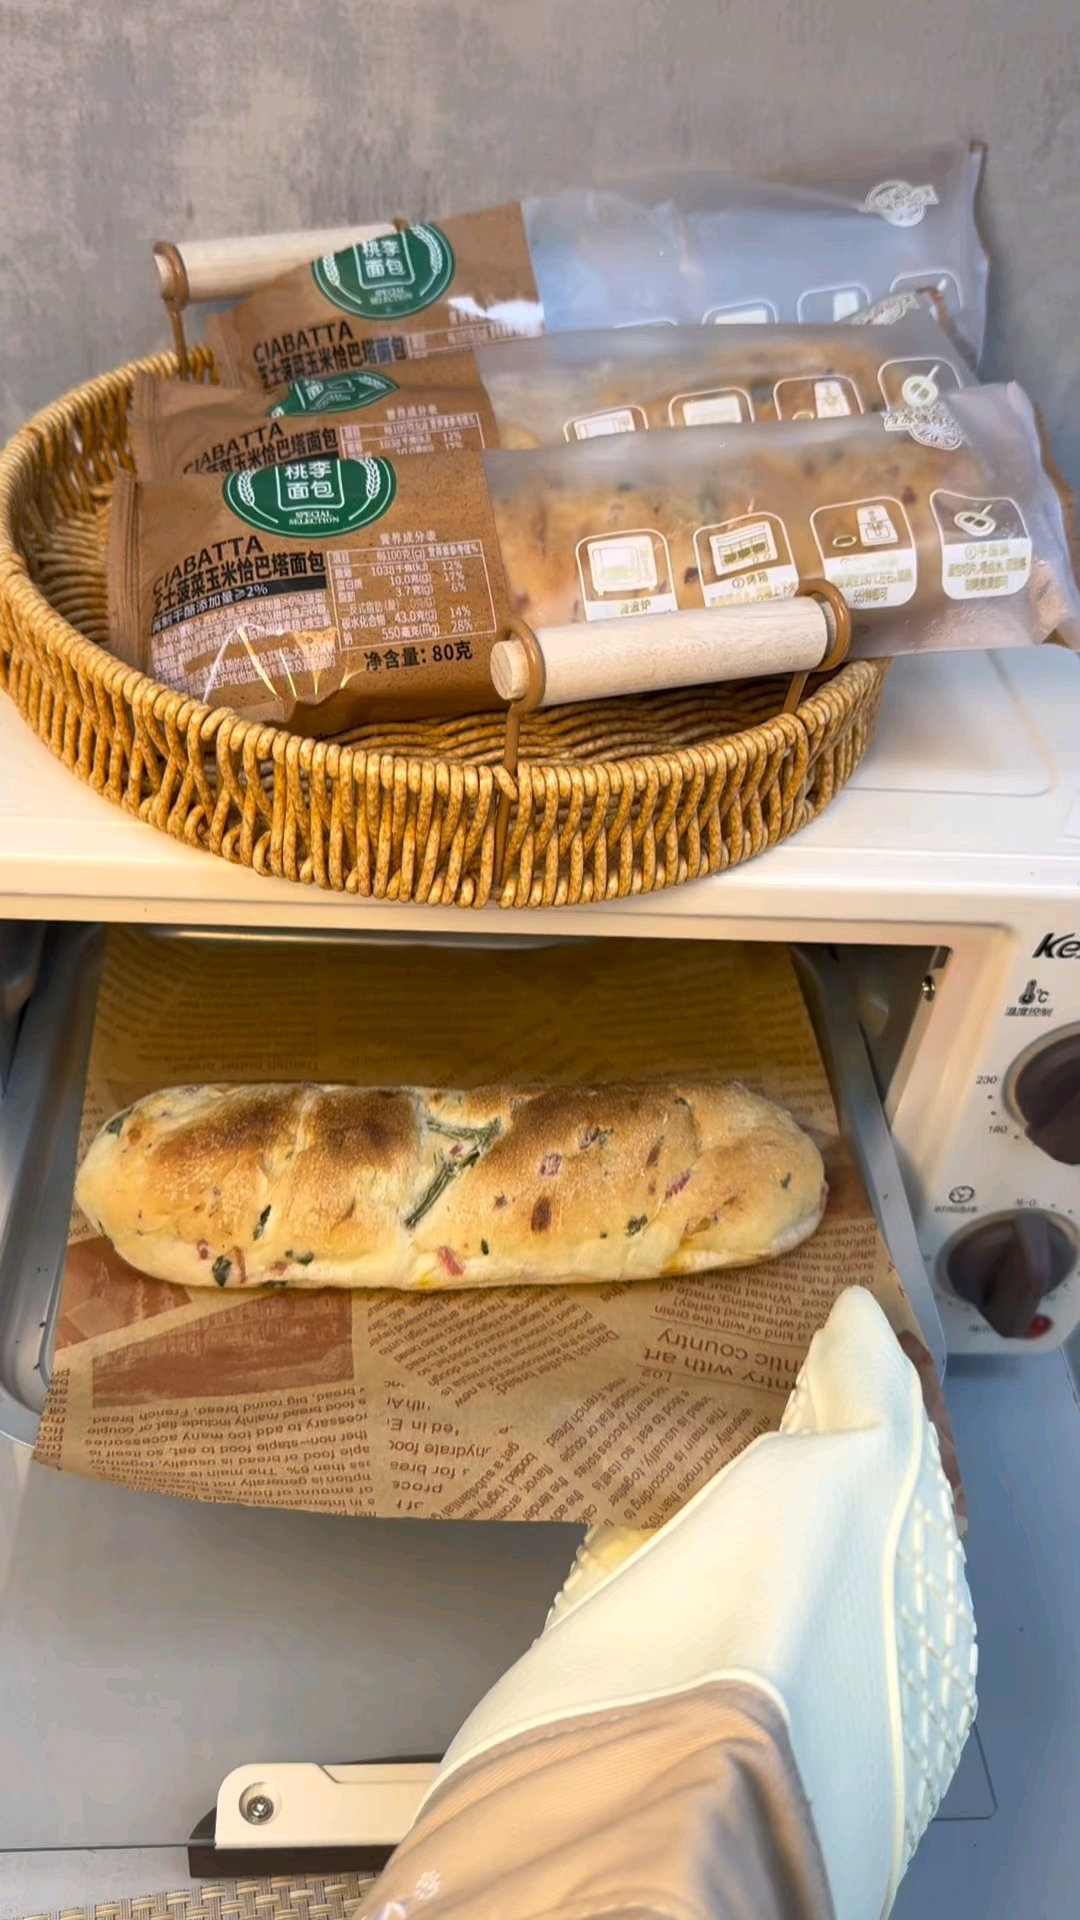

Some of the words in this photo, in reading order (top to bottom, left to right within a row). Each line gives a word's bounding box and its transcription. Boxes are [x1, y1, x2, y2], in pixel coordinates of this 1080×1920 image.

[364, 258, 405, 278] 面包
[253, 320, 353, 363] CIABATTA
[285, 460, 332, 479] 桃李
[287, 481, 334, 499] 面包
[290, 518, 339, 526] SELECTION
[296, 511, 332, 519] SPECIAL
[153, 535, 264, 595] CIABATTA
[442, 560, 462, 571] 12%
[444, 571, 465, 582] 17%
[451, 582, 467, 593] 6%
[451, 605, 471, 618] 14%
[451, 620, 473, 633] 28%
[1032, 932, 1080, 959] Ke
[976, 1075, 998, 1085] 230
[746, 1286, 792, 1305] Wheat
[654, 1303, 689, 1319] grain
[724, 1306, 747, 1321] and
[692, 1313, 714, 1326] the
[717, 1317, 745, 1334] with
[752, 1314, 794, 1330] wheat
[796, 1321, 811, 1330] of
[747, 1326, 761, 1337] of
[765, 1329, 793, 1341] kind
[570, 1327, 621, 1361] Danish
[657, 1328, 748, 1360] country
[643, 1347, 676, 1366] art
[684, 1357, 733, 1377] with
[286, 1395, 308, 1406] big
[452, 1385, 480, 1407] new
[242, 1399, 283, 1413] round
[282, 1406, 322, 1419] bread
[325, 1400, 354, 1412] food
[622, 1392, 654, 1425] many
[139, 1407, 189, 1421] French
[234, 1412, 279, 1426] mainly
[650, 1411, 666, 1427] to
[705, 1404, 728, 1428] The
[182, 1418, 231, 1429] include
[287, 1423, 302, 1433] to
[411, 1421, 427, 1433] in
[675, 1415, 691, 1430] is
[182, 1432, 223, 1441] many
[228, 1431, 252, 1439] too
[256, 1425, 283, 1437] add
[584, 1423, 600, 1439] or
[681, 1422, 710, 1452] main
[84, 1433, 178, 1447] accessories
[637, 1423, 683, 1471] usually,
[146, 1449, 164, 1458] so
[168, 1447, 197, 1457] eat,
[201, 1446, 215, 1455] to
[219, 1443, 252, 1454] food
[303, 1449, 335, 1461] food
[497, 1439, 522, 1464] get
[572, 1419, 630, 1481] accessories
[618, 1443, 636, 1462] so
[699, 1443, 721, 1465] not
[238, 1455, 280, 1466] bread
[284, 1452, 299, 1463] of
[672, 1449, 687, 1465] is
[313, 1461, 345, 1473] than
[492, 1458, 504, 1471] a
[206, 1468, 243, 1478] main
[248, 1467, 276, 1477] The
[430, 1466, 456, 1480] for
[674, 1461, 705, 1493] more
[240, 1476, 307, 1489] generally
[518, 1461, 554, 1498] flavor,
[548, 1474, 569, 1496] the
[604, 1464, 646, 1508] together
[628, 1459, 679, 1512] according
[295, 1486, 354, 1496] amount
[564, 1488, 585, 1509] the
[656, 1489, 682, 1516] than
[621, 1507, 637, 1522] to
